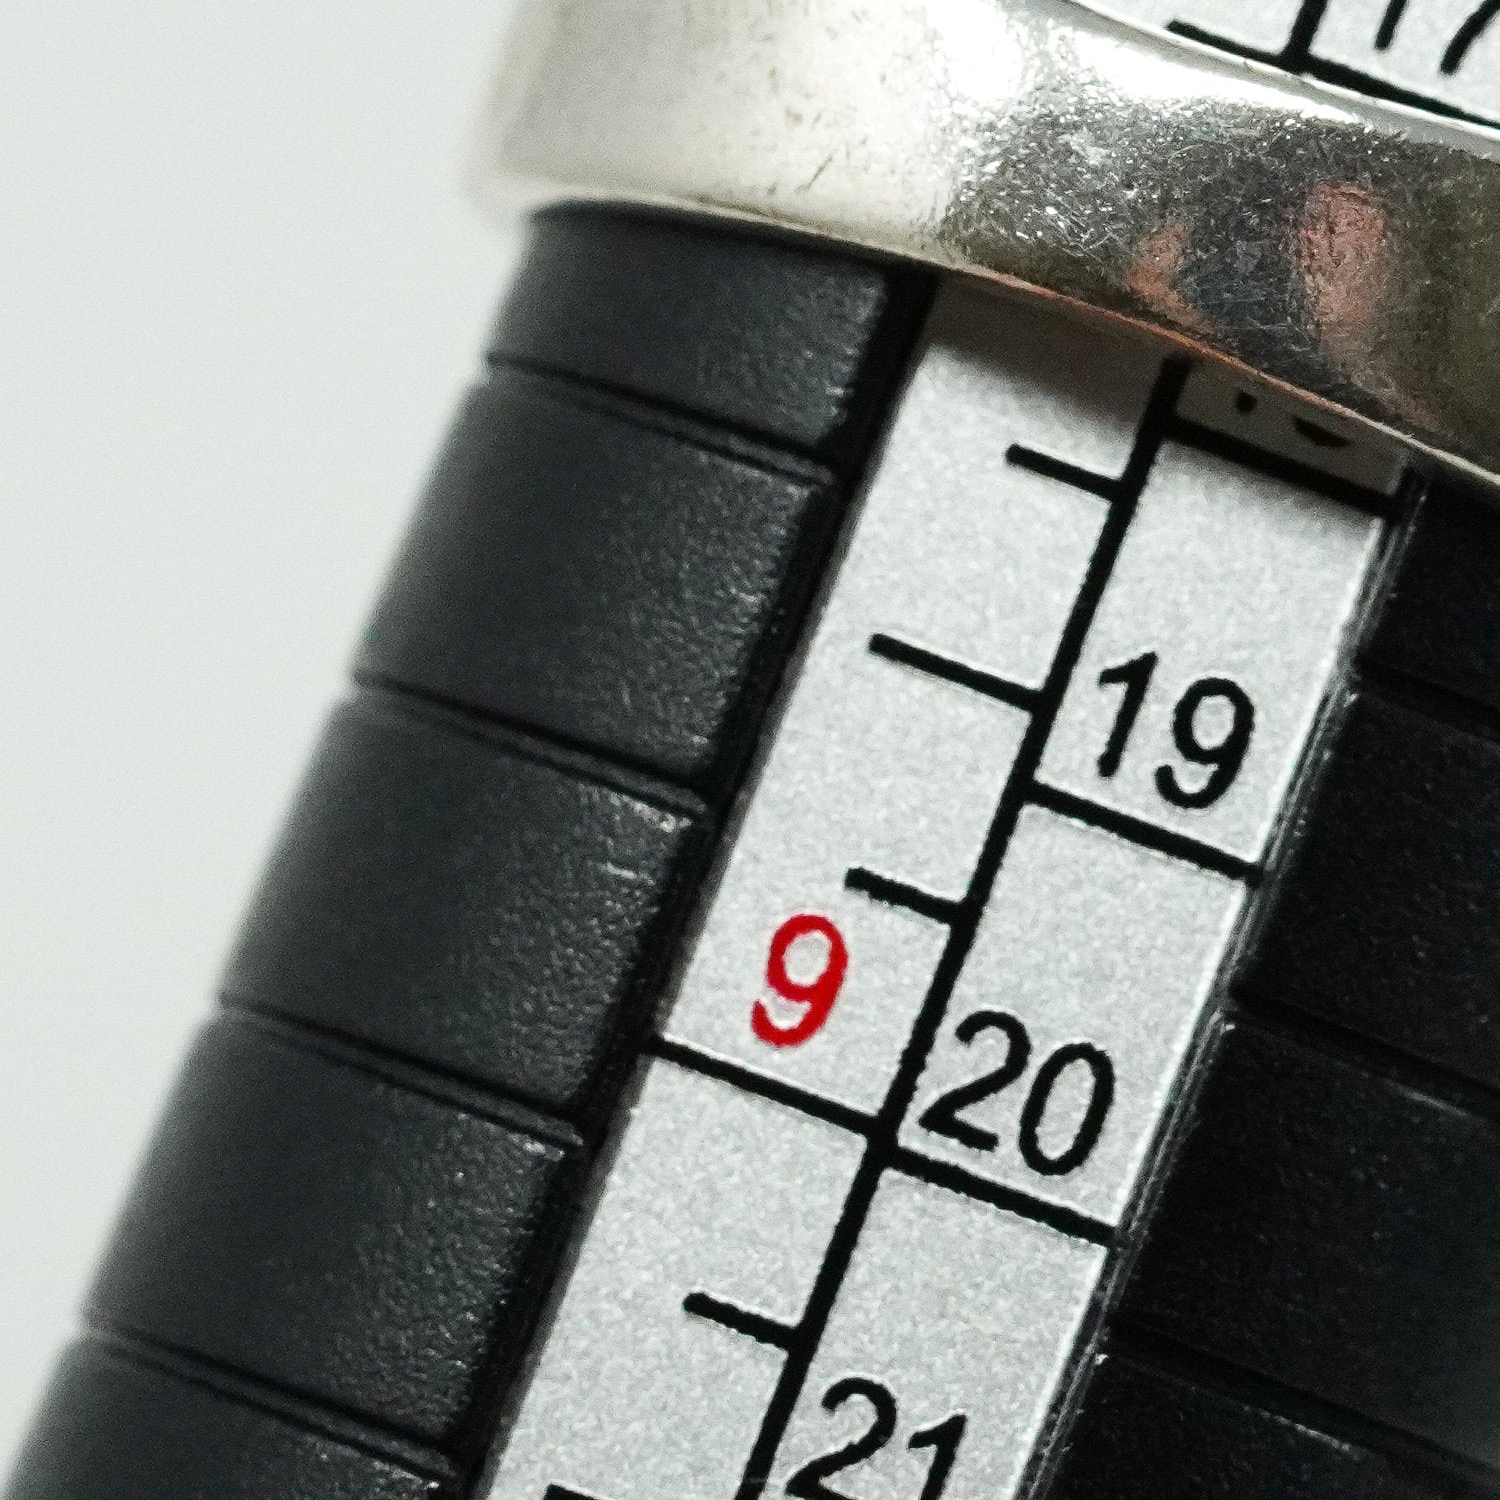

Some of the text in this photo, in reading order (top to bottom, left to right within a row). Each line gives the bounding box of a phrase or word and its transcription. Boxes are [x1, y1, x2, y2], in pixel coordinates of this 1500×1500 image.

[1096, 651, 1256, 810] 19
[751, 913, 849, 1049] 9
[917, 1010, 1117, 1177] 20
[783, 1376, 969, 1500] 21
